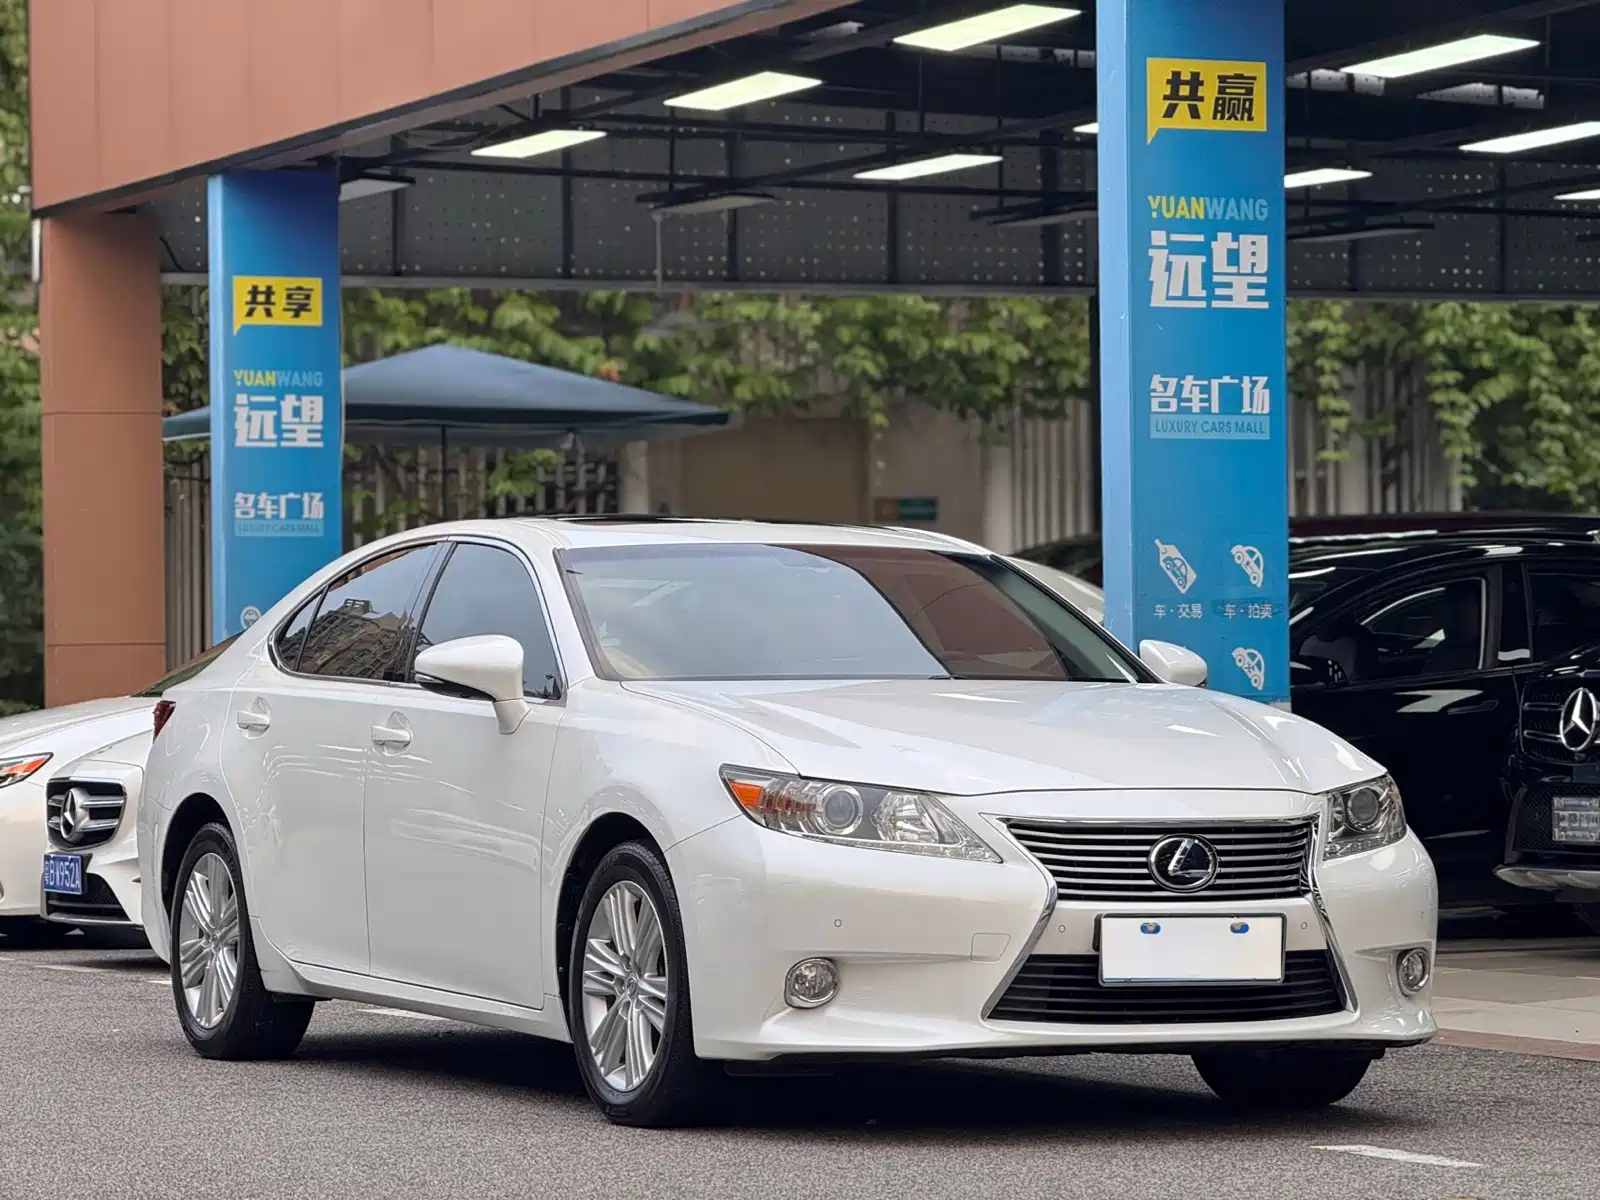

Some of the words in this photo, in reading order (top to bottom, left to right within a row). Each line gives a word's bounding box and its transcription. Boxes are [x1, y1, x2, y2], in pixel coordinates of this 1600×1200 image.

[1162, 70, 1257, 121] 共赢
[1147, 195, 1269, 221] YUANWANG
[1148, 230, 1269, 309] 远望
[245, 285, 314, 318] 共享
[233, 370, 324, 388] YUANWANG
[1150, 374, 1270, 414] 名车广场
[233, 393, 324, 448] 远望
[1155, 419, 1198, 433] LUXURY
[1200, 420, 1232, 433] CARS
[1235, 421, 1266, 434] MALL
[234, 492, 324, 520] 名车广场
